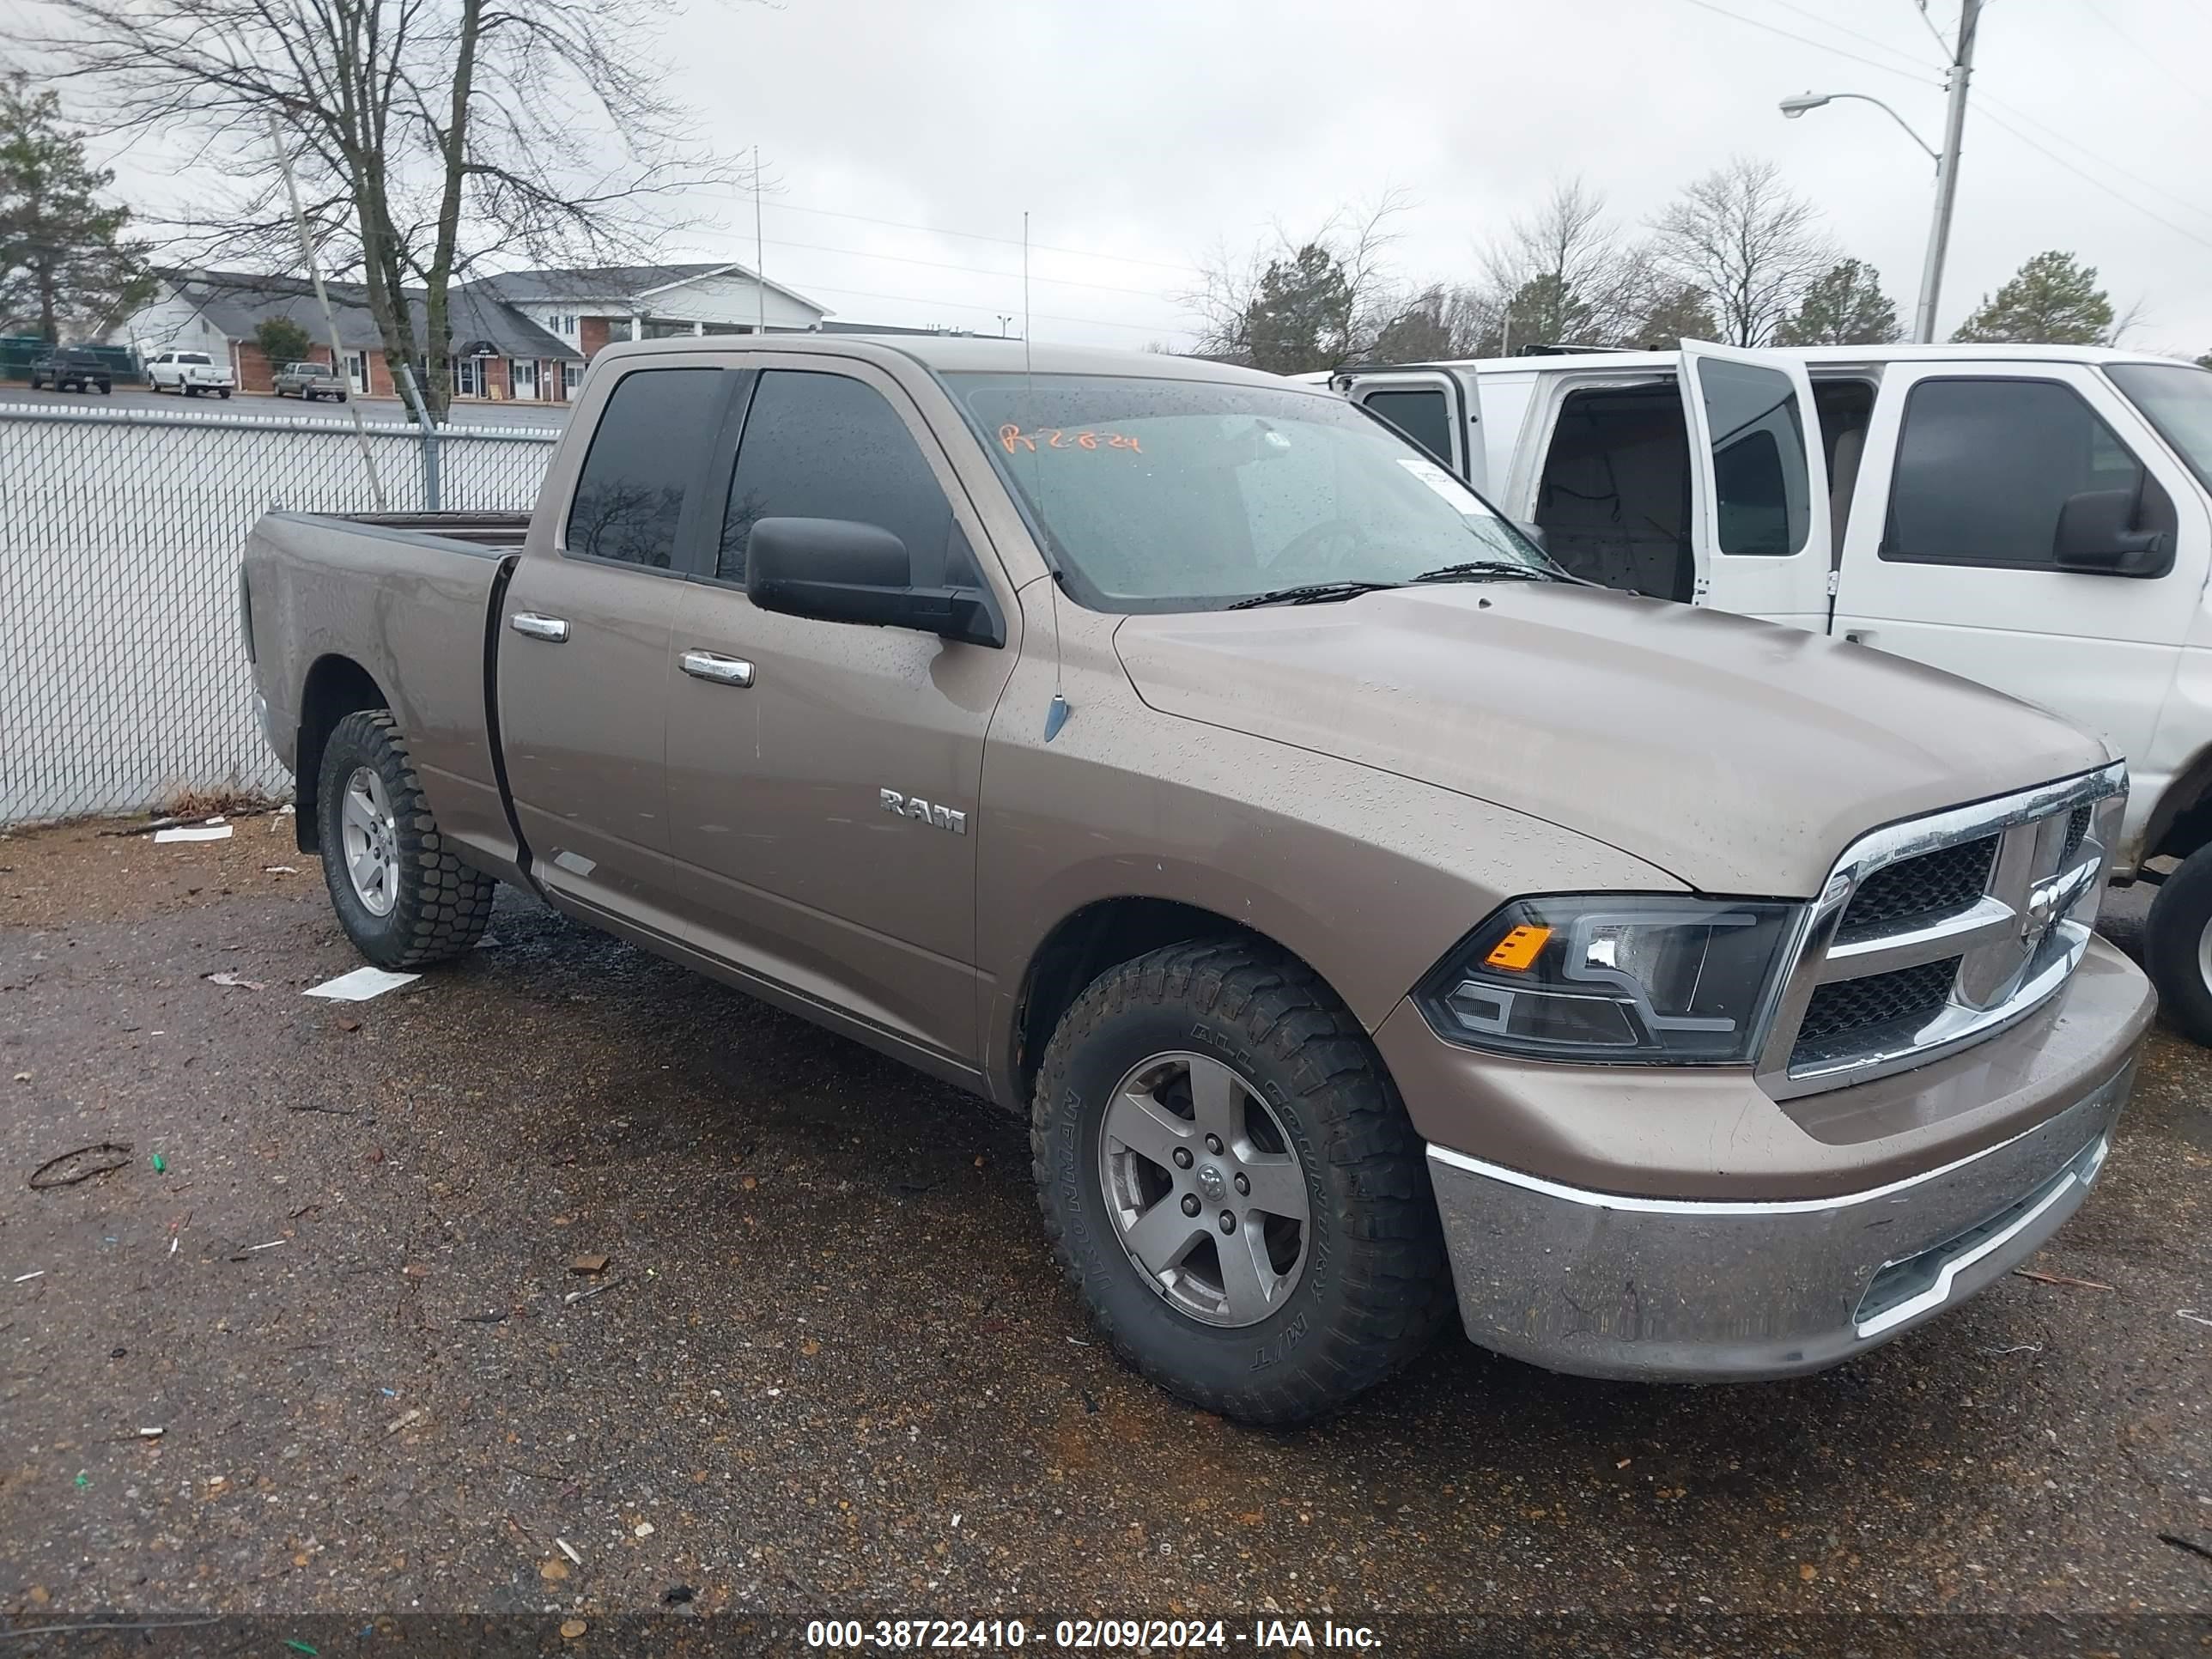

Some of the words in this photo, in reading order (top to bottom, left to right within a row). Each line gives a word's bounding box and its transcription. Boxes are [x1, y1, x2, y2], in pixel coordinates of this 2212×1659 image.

[879, 787, 968, 836] RAM
[1190, 1022, 1257, 1075] ALL
[1057, 1085, 1115, 1291] IRONMAN
[1265, 1079, 1331, 1307] COUNTRY
[1249, 1311, 1310, 1372] M/T
